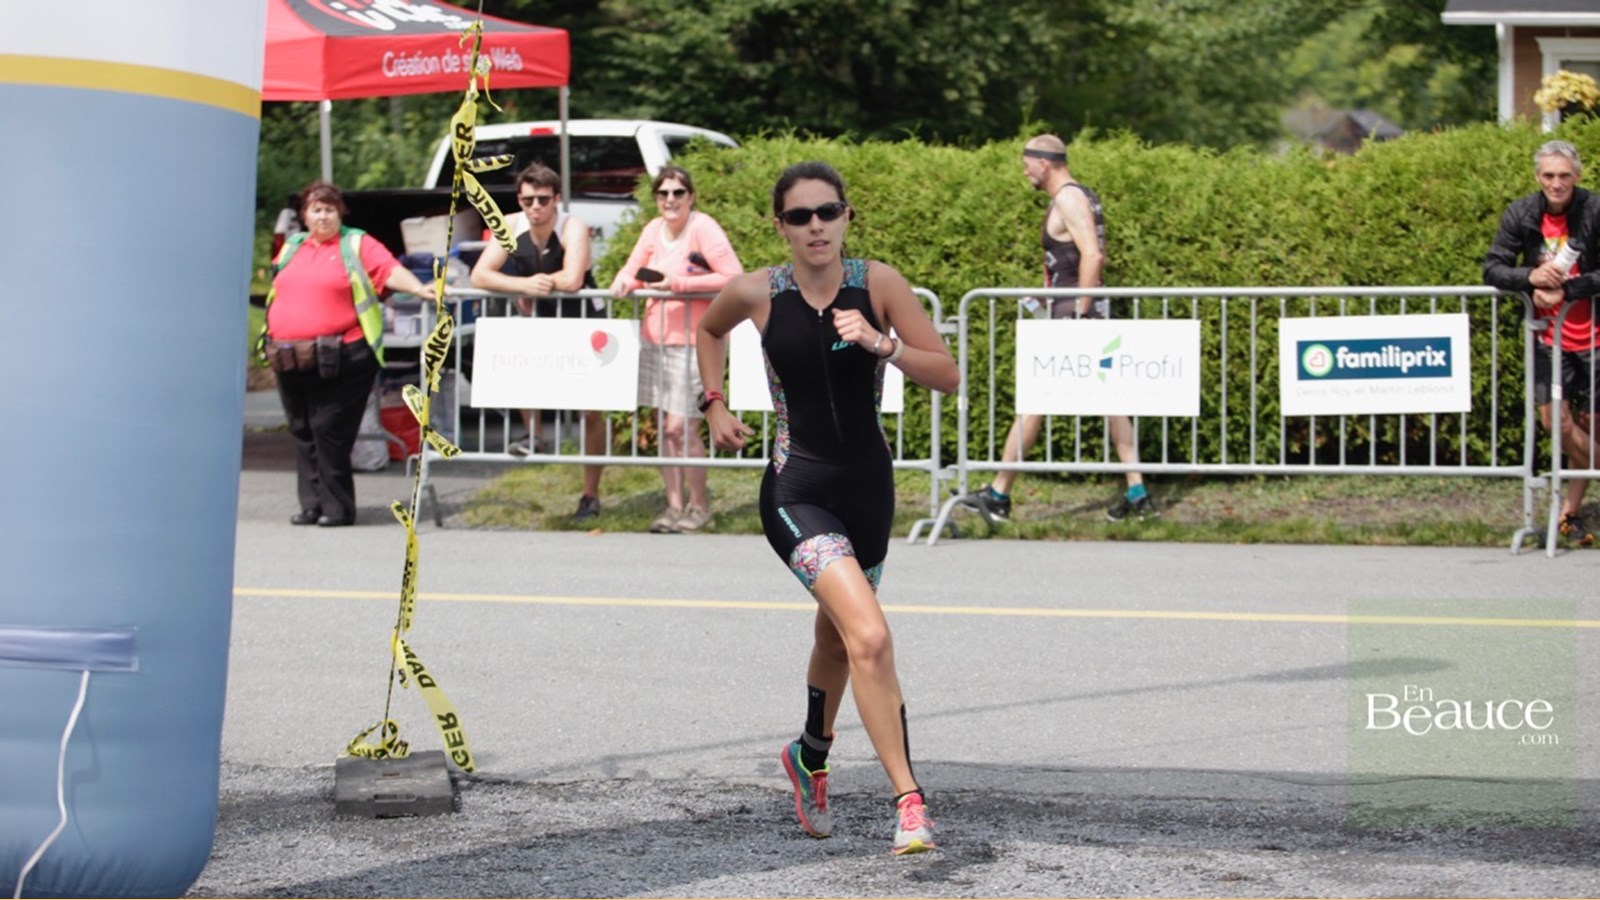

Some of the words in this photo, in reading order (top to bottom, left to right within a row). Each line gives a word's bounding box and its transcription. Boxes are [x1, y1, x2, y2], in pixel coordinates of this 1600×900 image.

[382, 51, 440, 78] Création
[441, 48, 461, 74] de
[490, 47, 524, 72] Web
[1033, 354, 1092, 378] MAB
[1119, 354, 1183, 379] Profil
[1335, 344, 1447, 374] familiprix
